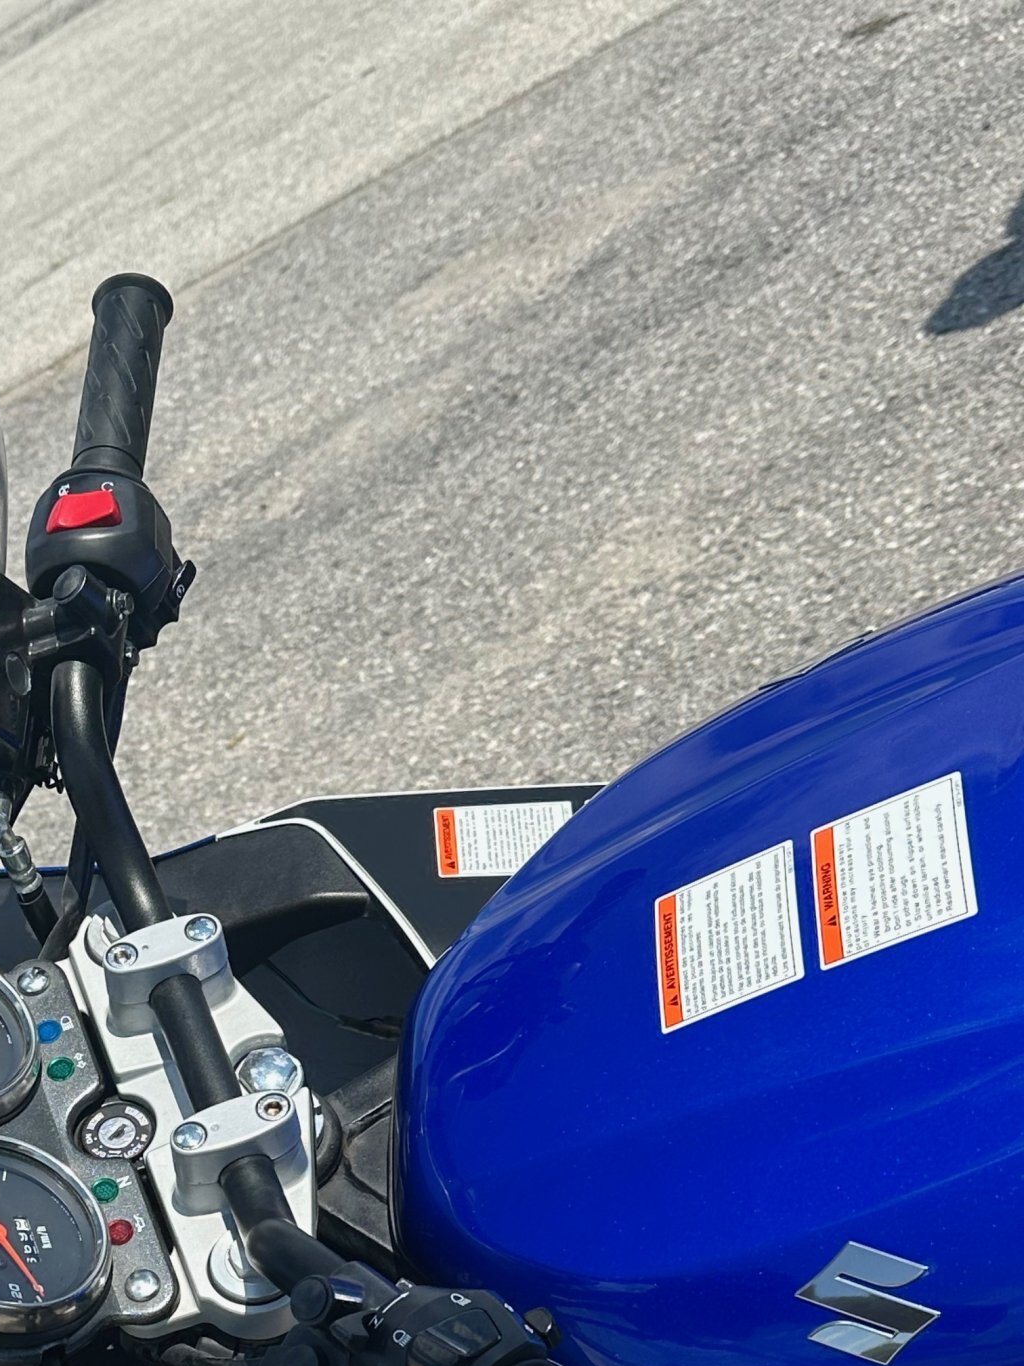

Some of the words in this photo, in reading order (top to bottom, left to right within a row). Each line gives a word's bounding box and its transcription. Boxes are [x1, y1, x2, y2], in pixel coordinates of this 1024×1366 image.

[886, 837, 894, 874] consuming
[821, 863, 832, 910] WARNING
[882, 911, 891, 932] bright
[663, 913, 675, 988] AVERTISSEMENT
[123, 1143, 144, 1158] LOCK
[117, 1175, 132, 1189] N
[36, 1225, 52, 1249] km/h
[9, 1283, 23, 1299] 20
